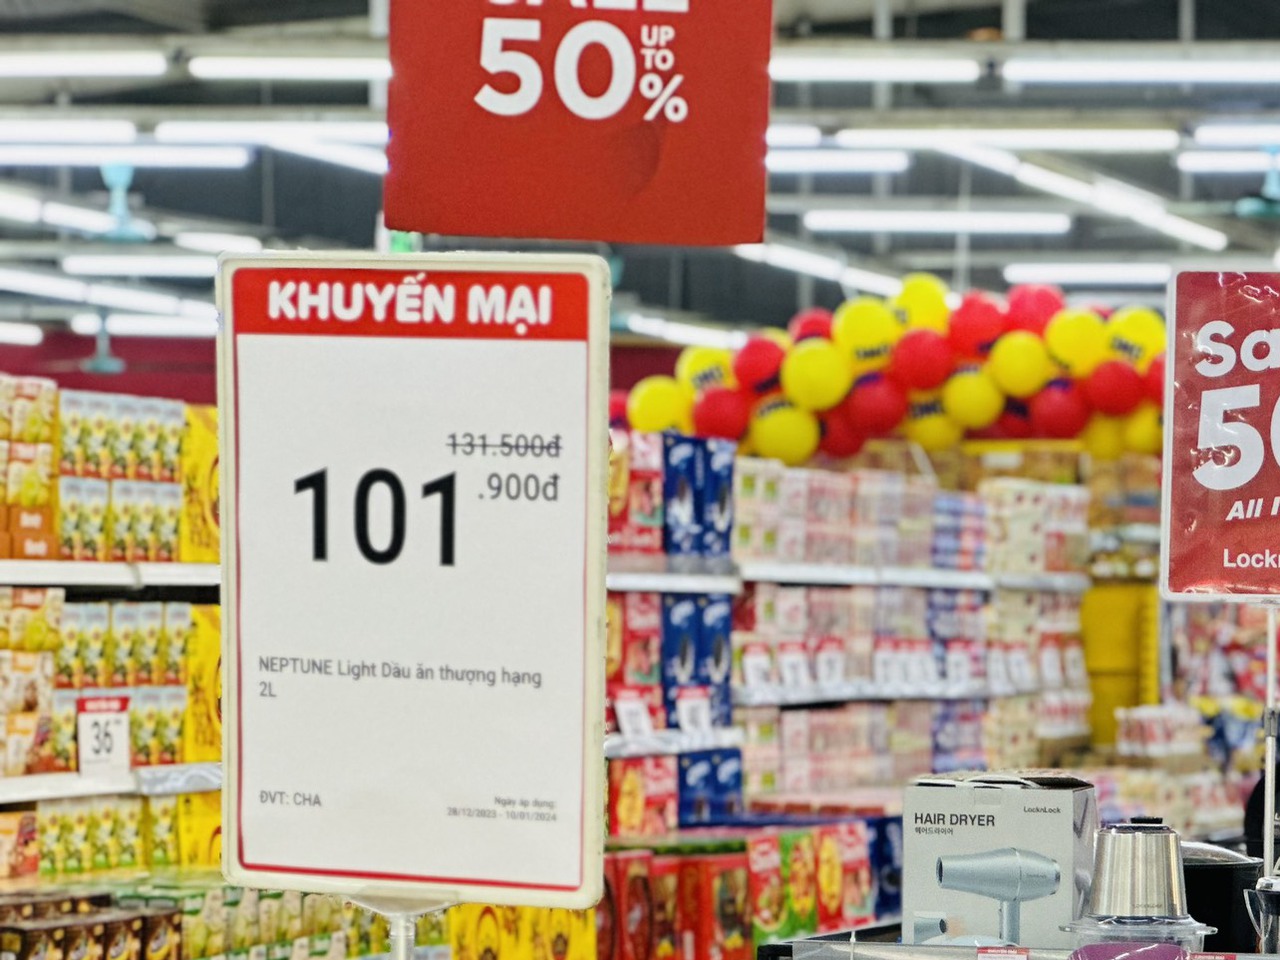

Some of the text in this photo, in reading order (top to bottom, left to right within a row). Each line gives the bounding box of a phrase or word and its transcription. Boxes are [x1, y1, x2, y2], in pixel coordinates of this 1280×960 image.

[641, 24, 676, 48] UP
[474, 17, 689, 123] 50 %
[640, 47, 675, 71] TO
[267, 274, 552, 335] KHUYẾN MẠI
[446, 433, 563, 459] 131.500đ
[294, 466, 458, 567] 101
[1226, 498, 1264, 521] All
[258, 655, 542, 689] NEPTUNE Light Dầu ăn thượng hạng
[259, 681, 277, 697] 2L
[259, 790, 322, 808] ĐVT: CHA
[914, 812, 996, 828] HAIR DRYER
